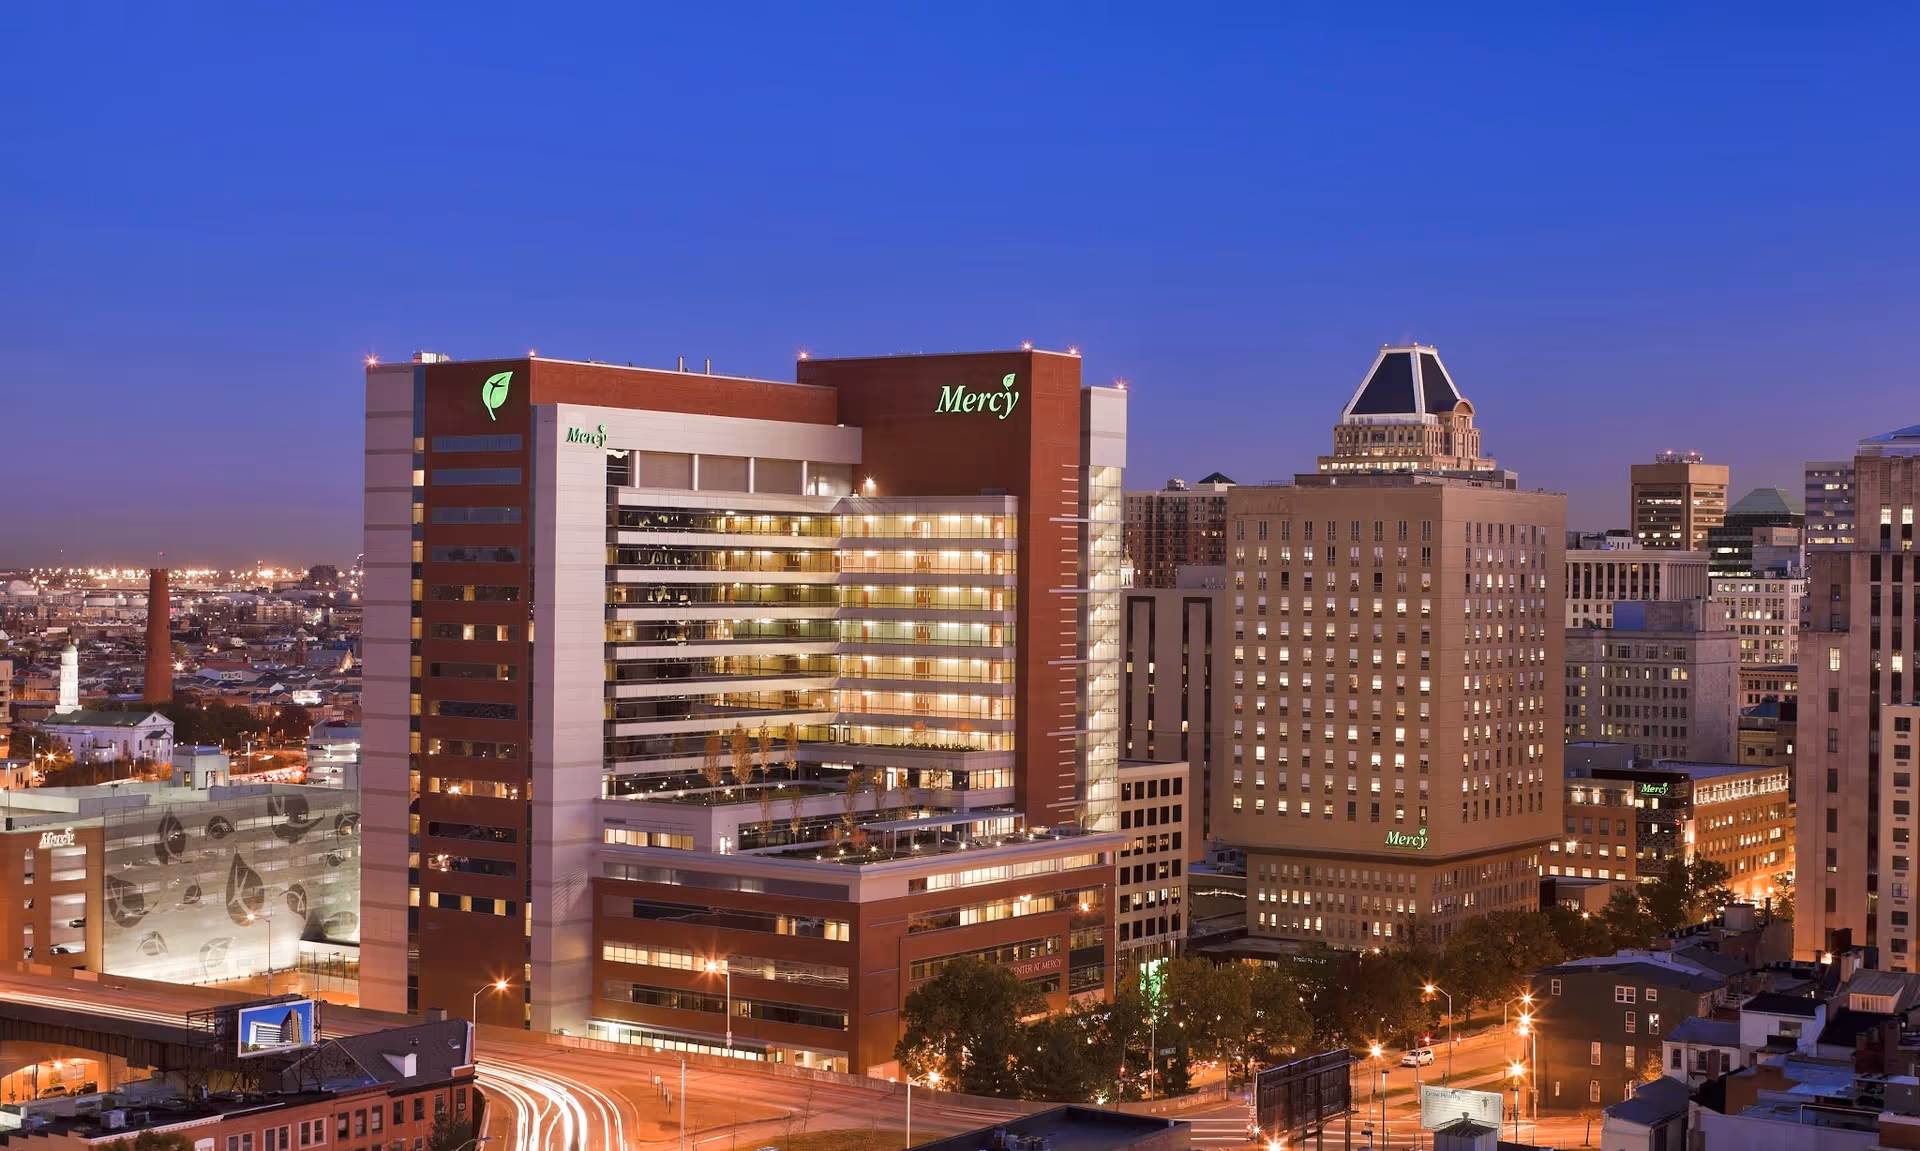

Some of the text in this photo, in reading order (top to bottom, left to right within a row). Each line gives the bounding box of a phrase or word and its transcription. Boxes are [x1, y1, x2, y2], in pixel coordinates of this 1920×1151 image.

[935, 385, 1019, 419] Mercy
[566, 427, 608, 448] Mercy
[1641, 783, 1668, 795] Mercy
[1385, 831, 1428, 849] Mercy
[1034, 962, 1041, 972] AT
[1042, 959, 1062, 969] MERCY
